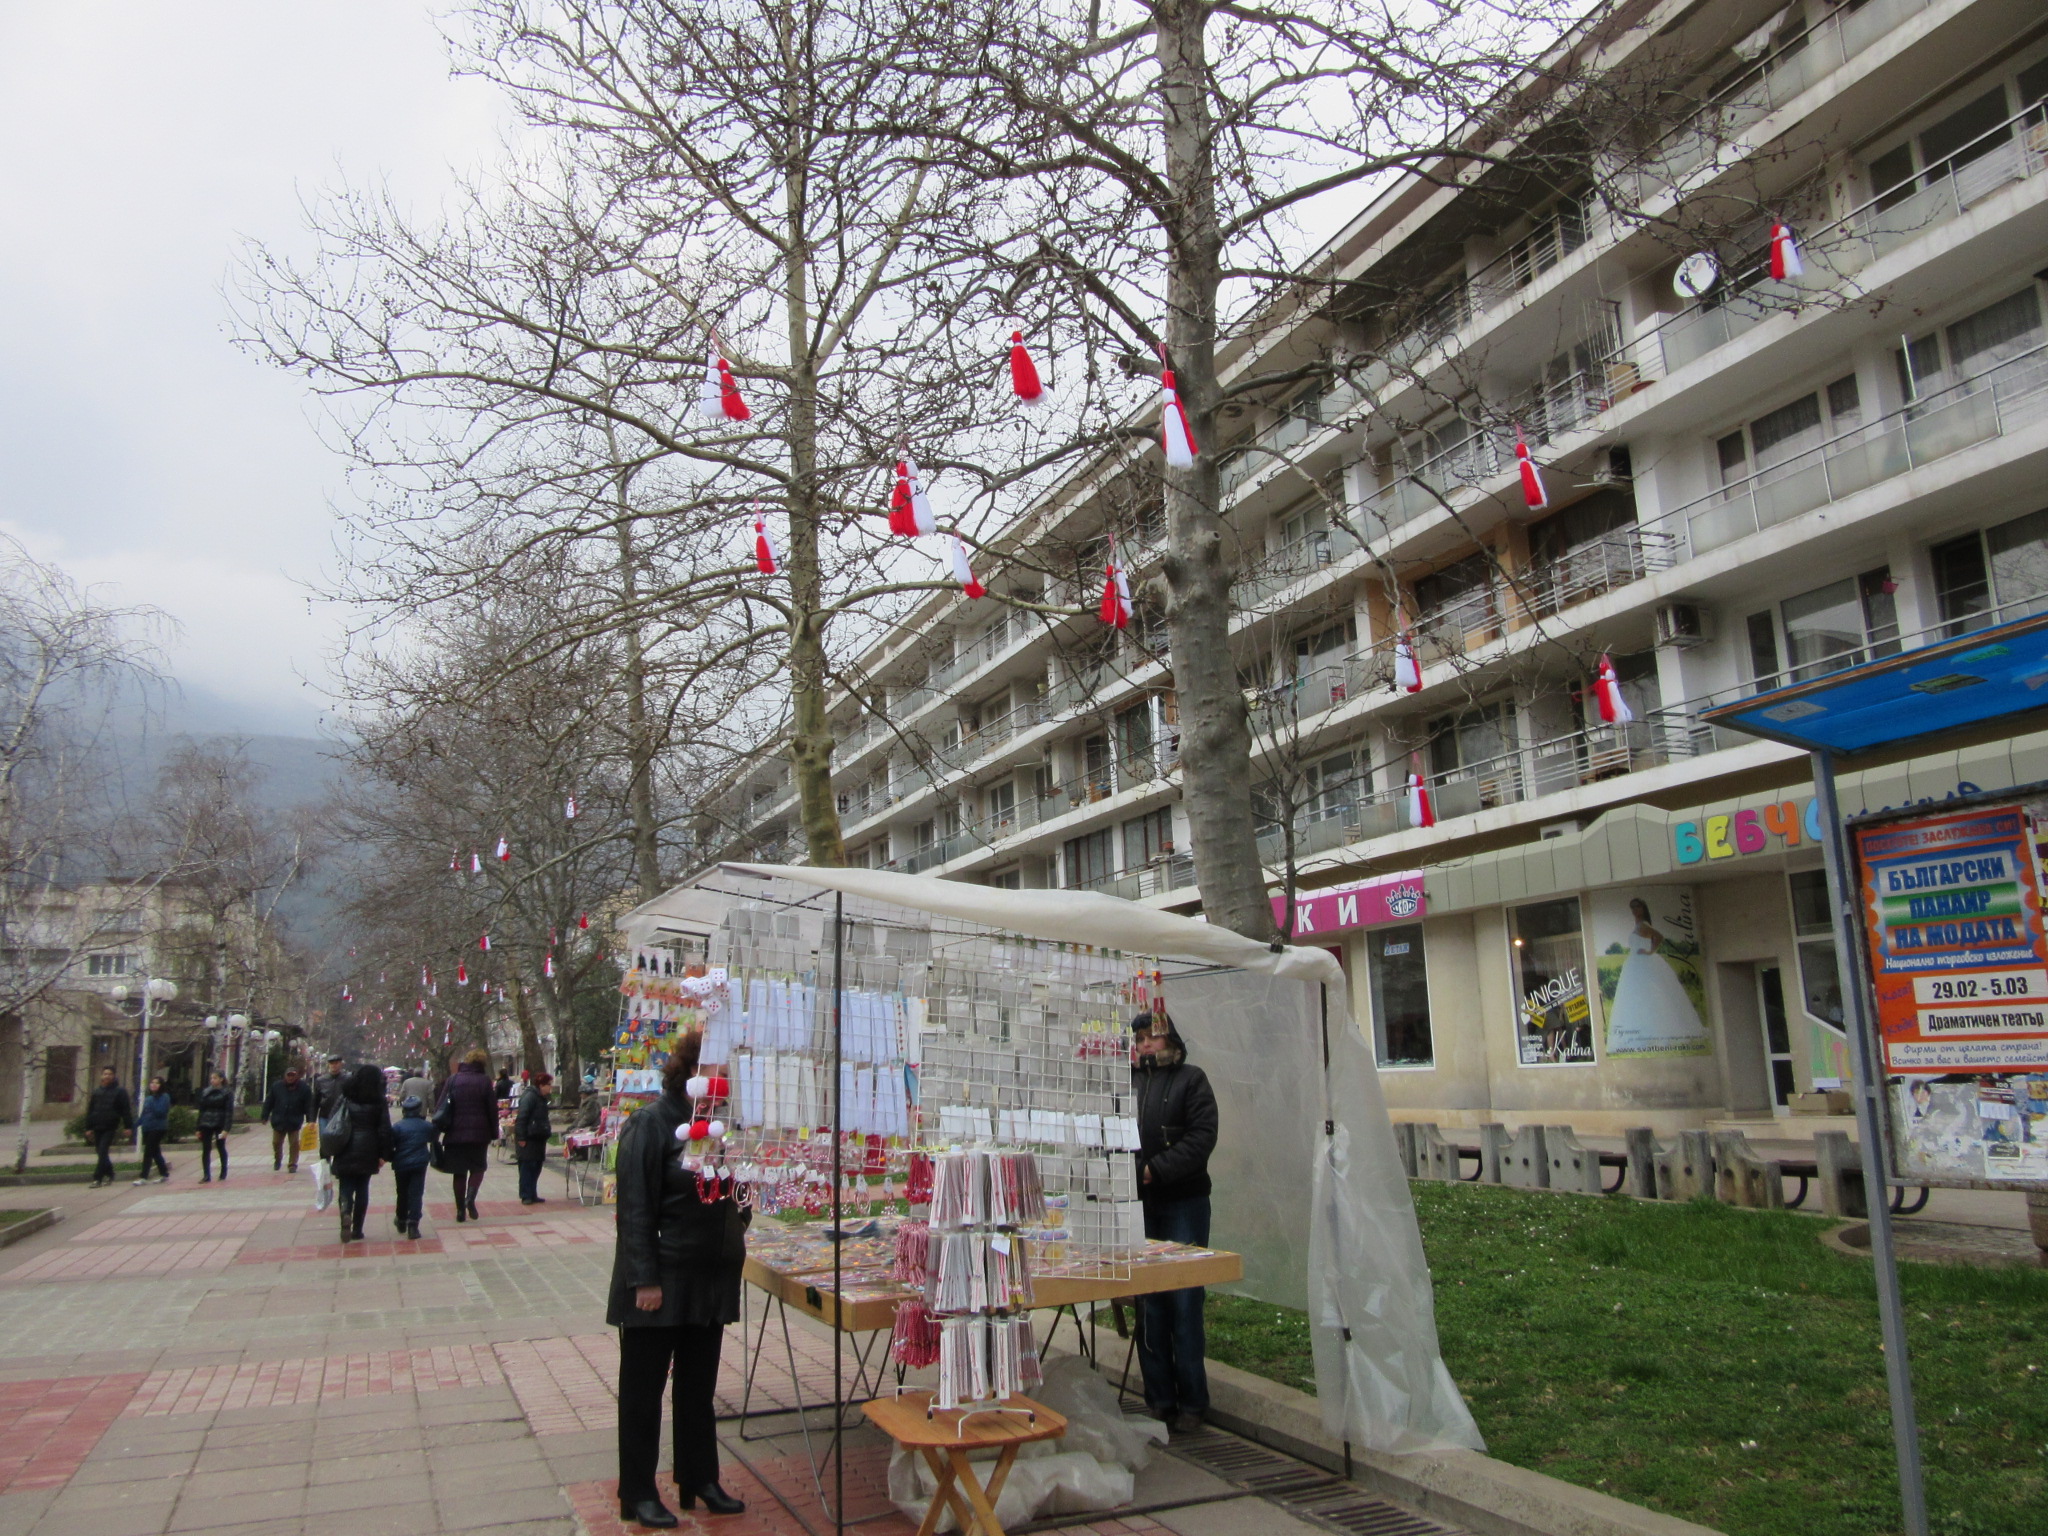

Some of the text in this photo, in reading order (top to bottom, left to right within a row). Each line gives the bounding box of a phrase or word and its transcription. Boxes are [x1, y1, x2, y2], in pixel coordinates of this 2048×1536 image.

[1888, 856, 2005, 892] БЪЛГАРСКИ
[1909, 890, 1991, 919] ПАНАИР
[1662, 893, 1698, 976] Kalina
[1894, 918, 2017, 949] НА МОДАТА
[1886, 949, 2033, 970] Национално търговско изложение
[1524, 967, 1582, 1012] UNIQUE
[1932, 980, 1978, 999] 29.02
[1990, 977, 2029, 995] 5.03
[1928, 1012, 2045, 1031] Драматичен театър
[1545, 1030, 1591, 1057] Kalina
[1904, 1044, 1937, 1055] Фирми
[1959, 1044, 1997, 1053] цялата
[2000, 1041, 2042, 1053] страна!
[1892, 1056, 1921, 1065] Всичко
[1937, 1054, 1951, 1064] вас
[1963, 1054, 2001, 1064] вашето
